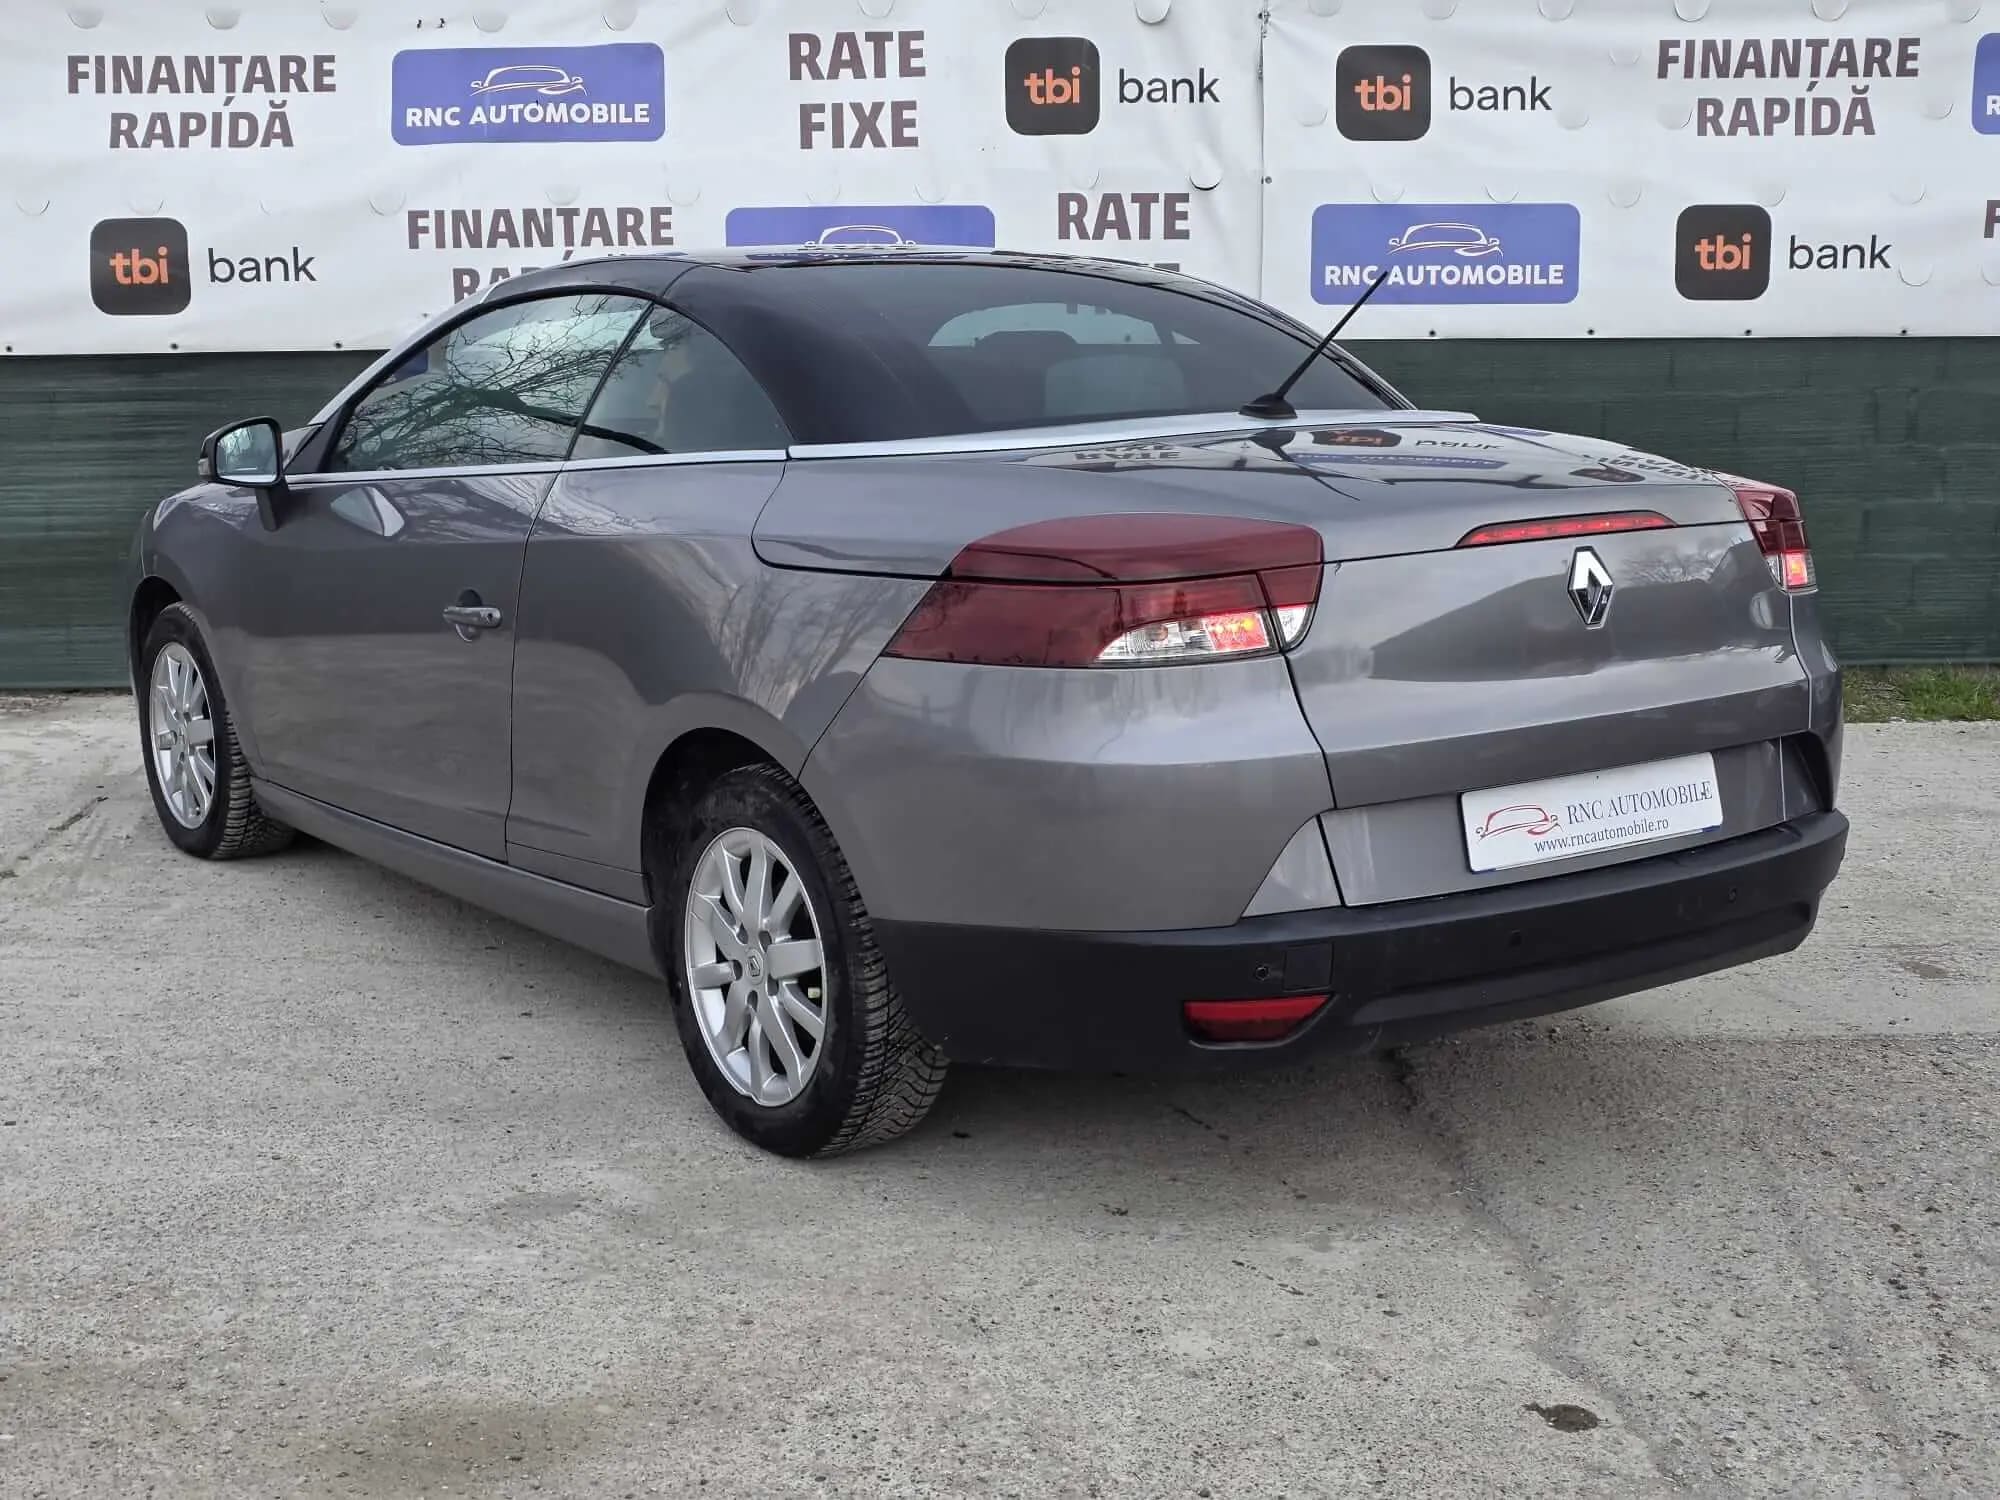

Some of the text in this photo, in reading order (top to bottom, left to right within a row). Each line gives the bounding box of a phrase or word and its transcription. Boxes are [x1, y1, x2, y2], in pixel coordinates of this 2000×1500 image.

[789, 31, 925, 80] RATE
[1025, 67, 1220, 104] tbi bank
[1355, 74, 1552, 110] tbi bank
[406, 103, 649, 127] RNC AUTOMOBILE
[800, 101, 918, 149] FIXE
[1058, 193, 1189, 240] RATE
[110, 247, 316, 285] tbi bank
[1694, 234, 1892, 270] tbi bank
[1325, 265, 1563, 286] RNC AUTOMOBILE
[1567, 781, 1713, 825] RNC AUTOMOBILE
[1534, 816, 1670, 853] www.rncautomobile.ro
